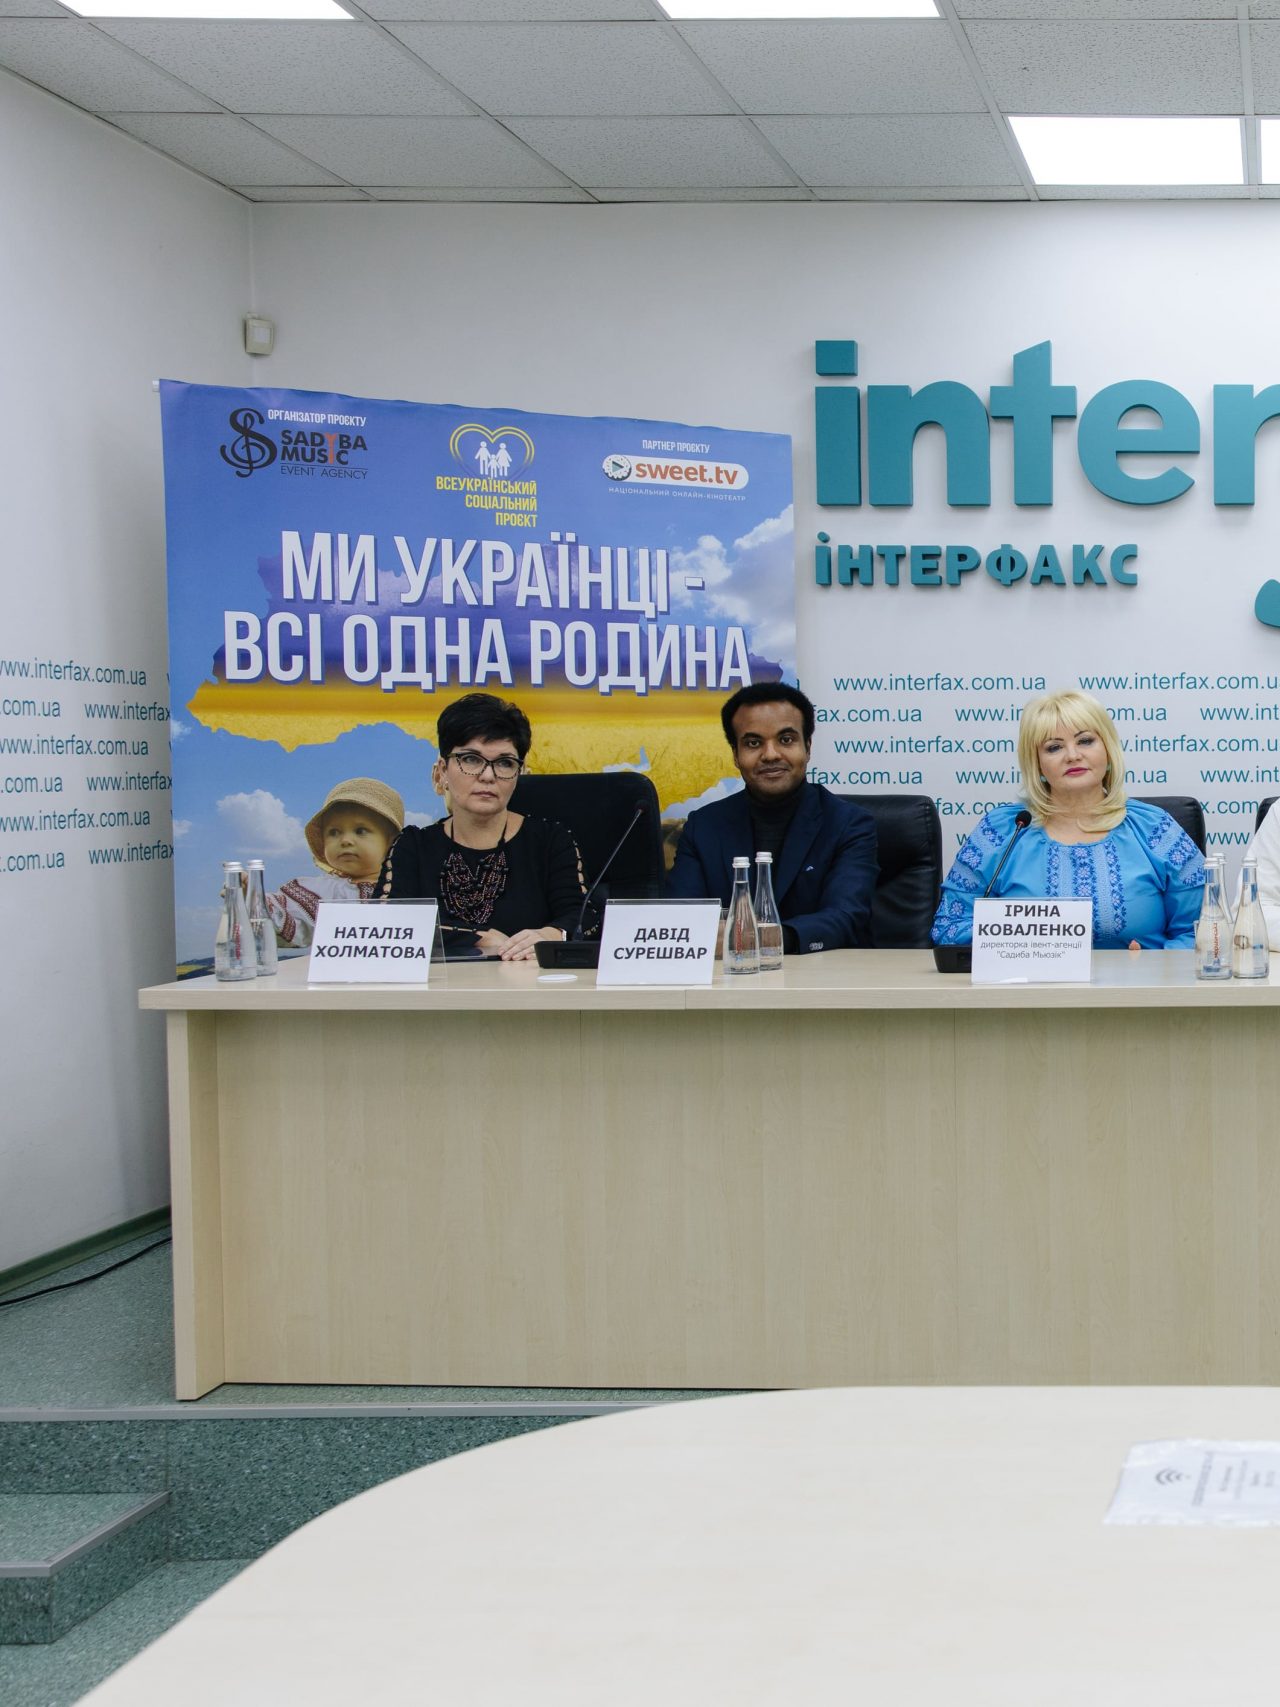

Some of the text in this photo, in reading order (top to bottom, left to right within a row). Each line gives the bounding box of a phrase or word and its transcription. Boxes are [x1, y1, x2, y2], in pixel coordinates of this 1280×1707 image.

[268, 409, 366, 427] ОРГАНІЗАТОР ПРОЄКТУ
[642, 439, 710, 453] ПАРТНЕР ПРОЄКТУ
[281, 466, 368, 480] EVENT AGENCY
[635, 463, 738, 485] sweet.tv
[436, 476, 537, 495] ВСЕУКРАЇНСЬКИЙ
[609, 487, 670, 497] НАЦІОНАЛЬНИЙ
[465, 494, 537, 511] СОЦІАЛЬНИЙ
[495, 512, 538, 527] ПРОЄКТ
[281, 530, 377, 603] МИ
[392, 531, 669, 618] УКРАЇНЦІ
[224, 611, 753, 694] ВСІ ОДНА РОДИНА
[834, 673, 1046, 691] www.interfax.com.ua
[1004, 905, 1060, 917] ІРИНА
[334, 926, 413, 940] НАТАЛІЯ
[634, 928, 690, 943] ДАВІД
[978, 923, 1086, 936] КОВАЛЕНКО
[315, 945, 426, 959] ХОЛМАТОВА
[613, 947, 707, 960] СУРЕШВАР
